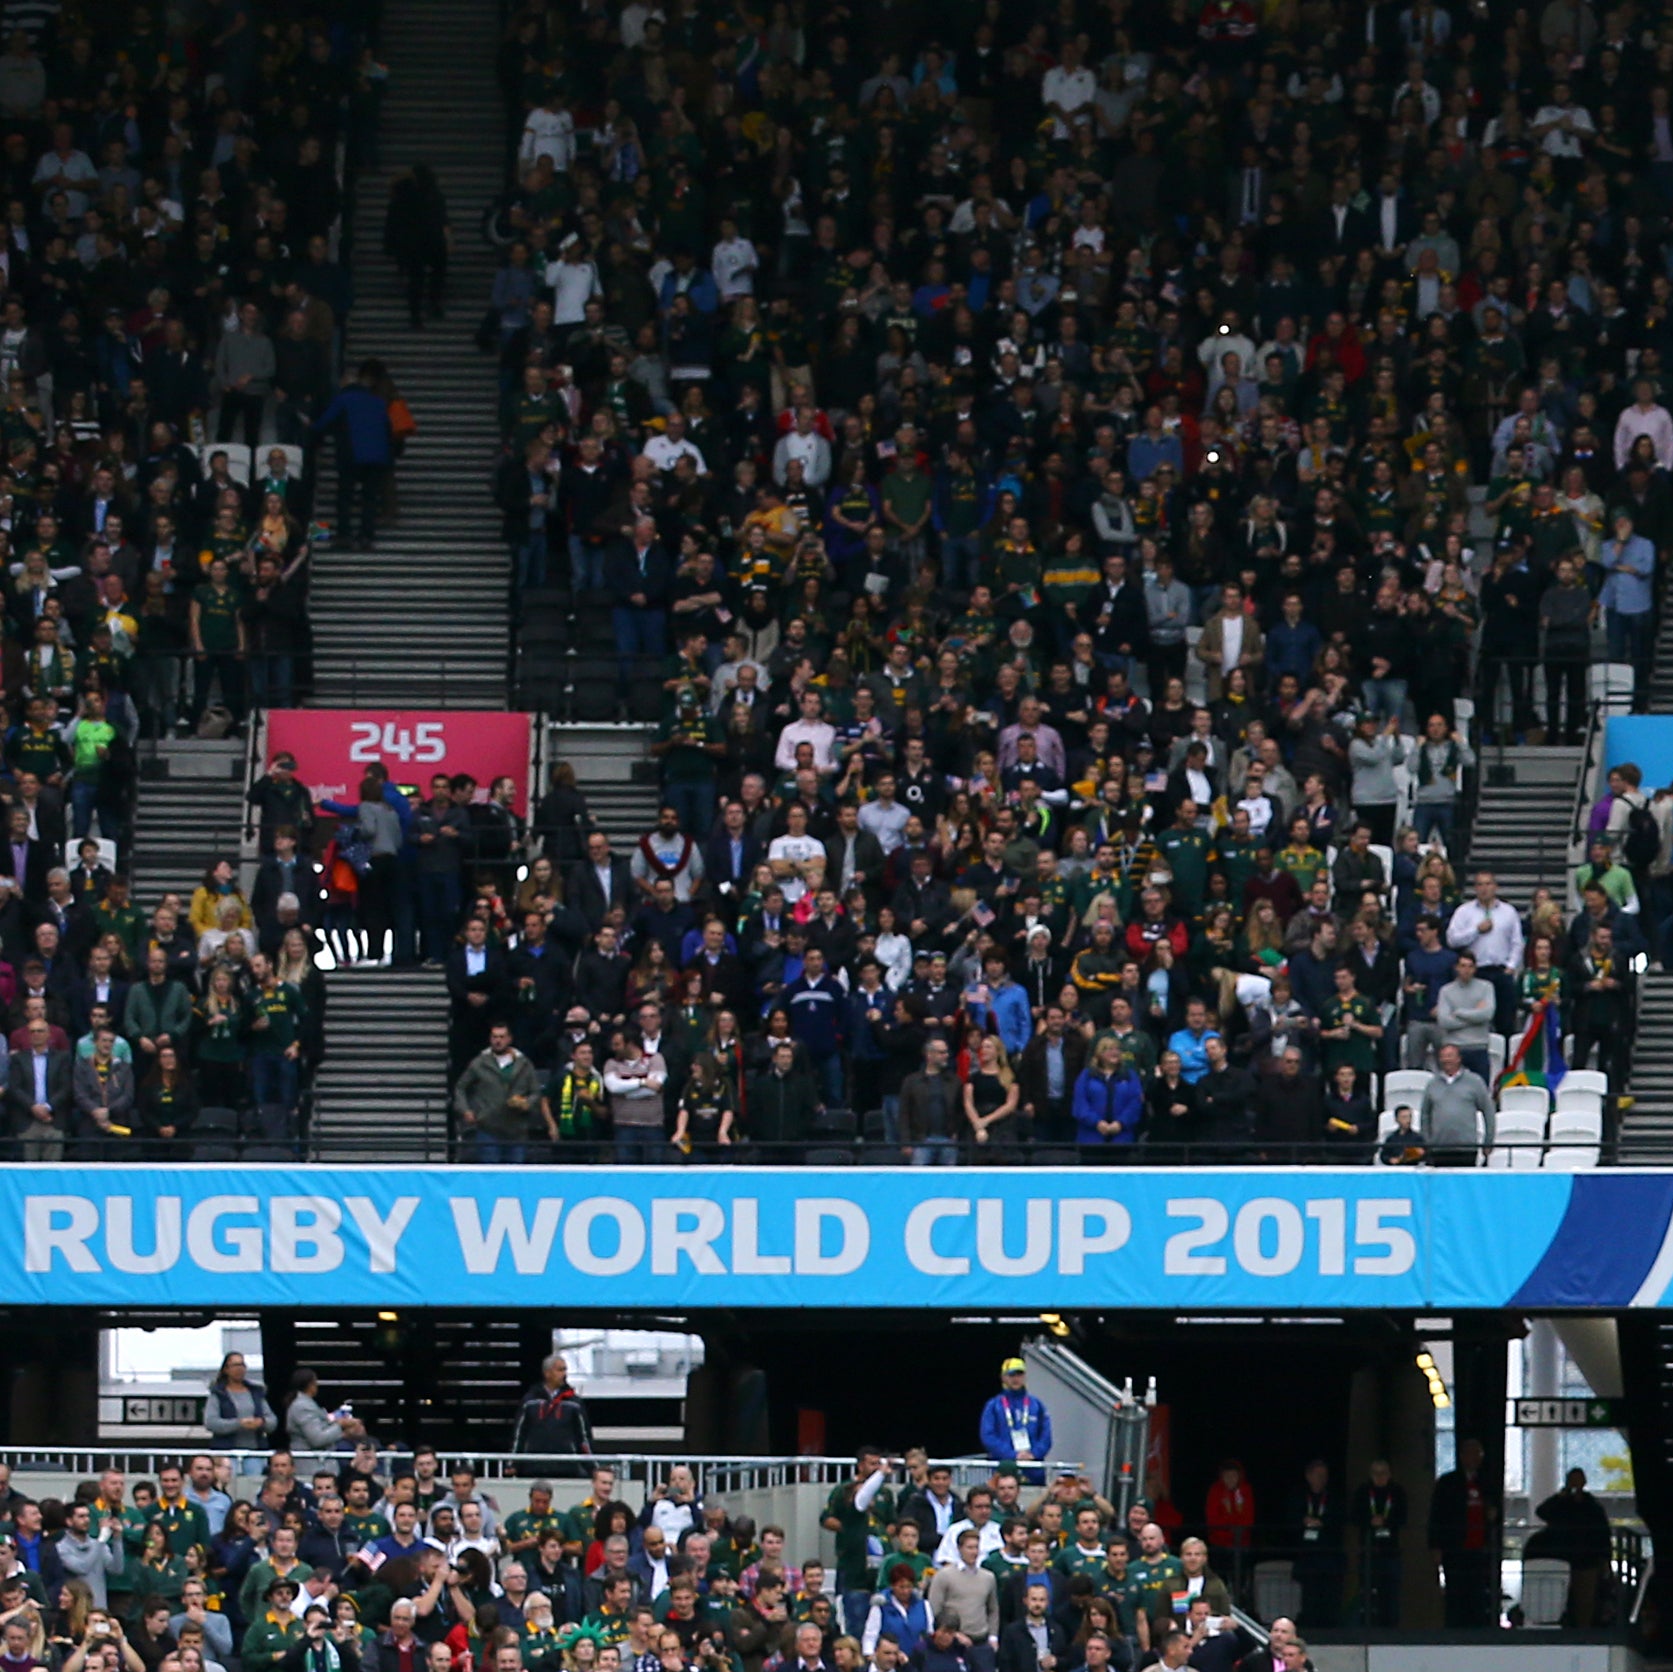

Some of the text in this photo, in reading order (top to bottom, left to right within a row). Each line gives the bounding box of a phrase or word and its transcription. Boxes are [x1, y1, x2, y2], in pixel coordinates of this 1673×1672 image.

[351, 722, 447, 763] 245
[23, 1194, 1417, 1277] RUGBY WORLD CUP 2015
